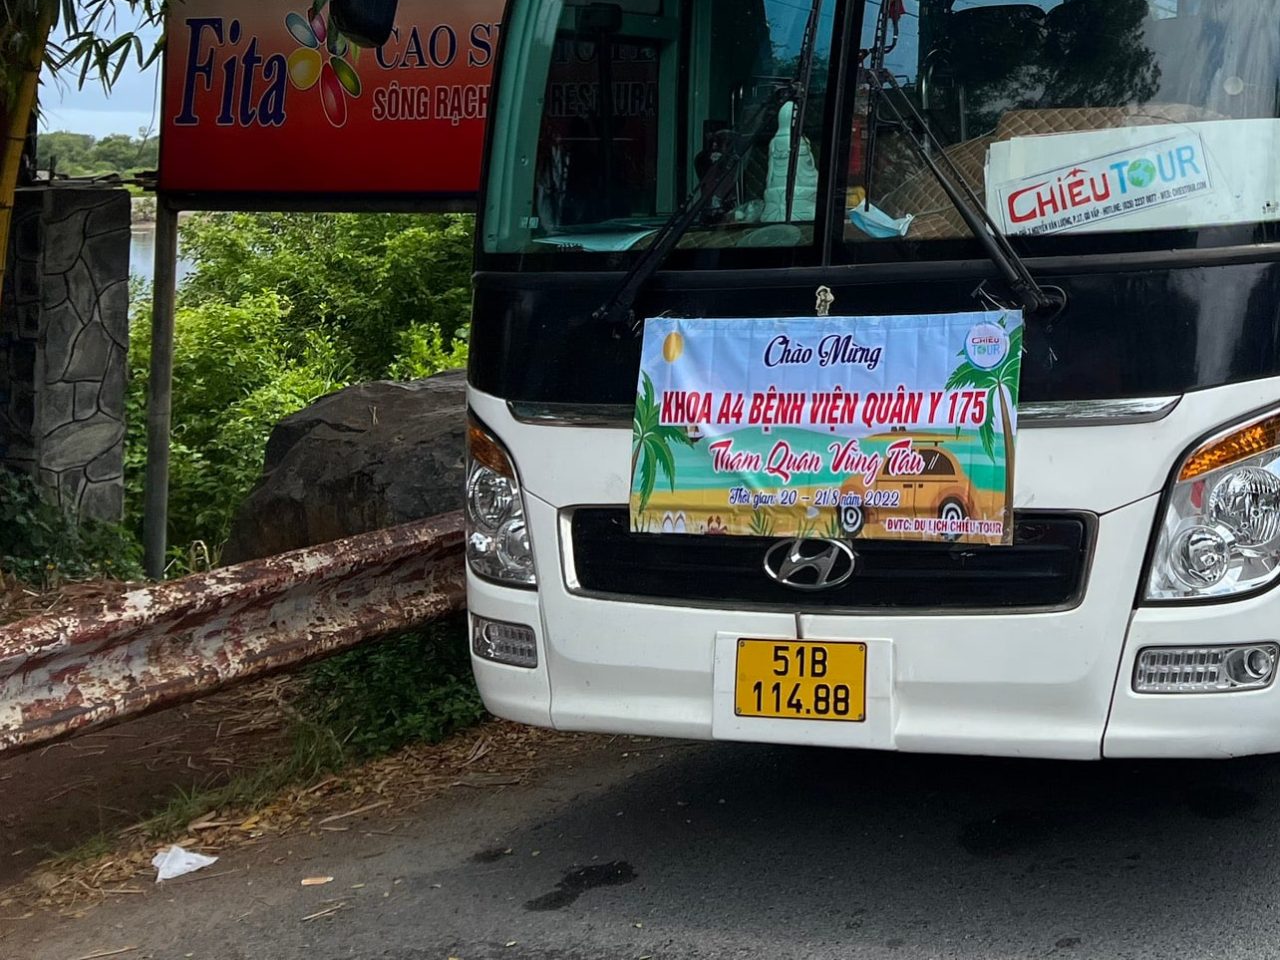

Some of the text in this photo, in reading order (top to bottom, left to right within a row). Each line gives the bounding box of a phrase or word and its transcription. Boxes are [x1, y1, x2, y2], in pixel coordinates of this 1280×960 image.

[373, 24, 457, 69] CAO
[467, 22, 501, 68] S
[173, 16, 287, 127] Fita
[372, 82, 430, 121] SÔNG
[1110, 144, 1201, 195] TOUR
[764, 334, 882, 371] Chào Mừng
[660, 384, 988, 432] KHOA A4 BỆNH VIỆN QUÂN Y 175
[708, 438, 925, 486] Tham Quan Vũng Tàu
[729, 487, 751, 505] Thời
[752, 493, 776, 510] gian:
[780, 490, 797, 506] 20
[815, 488, 840, 506] 21/8
[840, 493, 862, 506] năm
[864, 490, 899, 507] 2022
[887, 518, 912, 531] ĐVTC:
[914, 519, 925, 531] DU
[928, 520, 946, 534] LỊCH
[979, 521, 1003, 534] TOUR
[773, 645, 828, 678] 51B
[753, 681, 850, 716] 114.88
